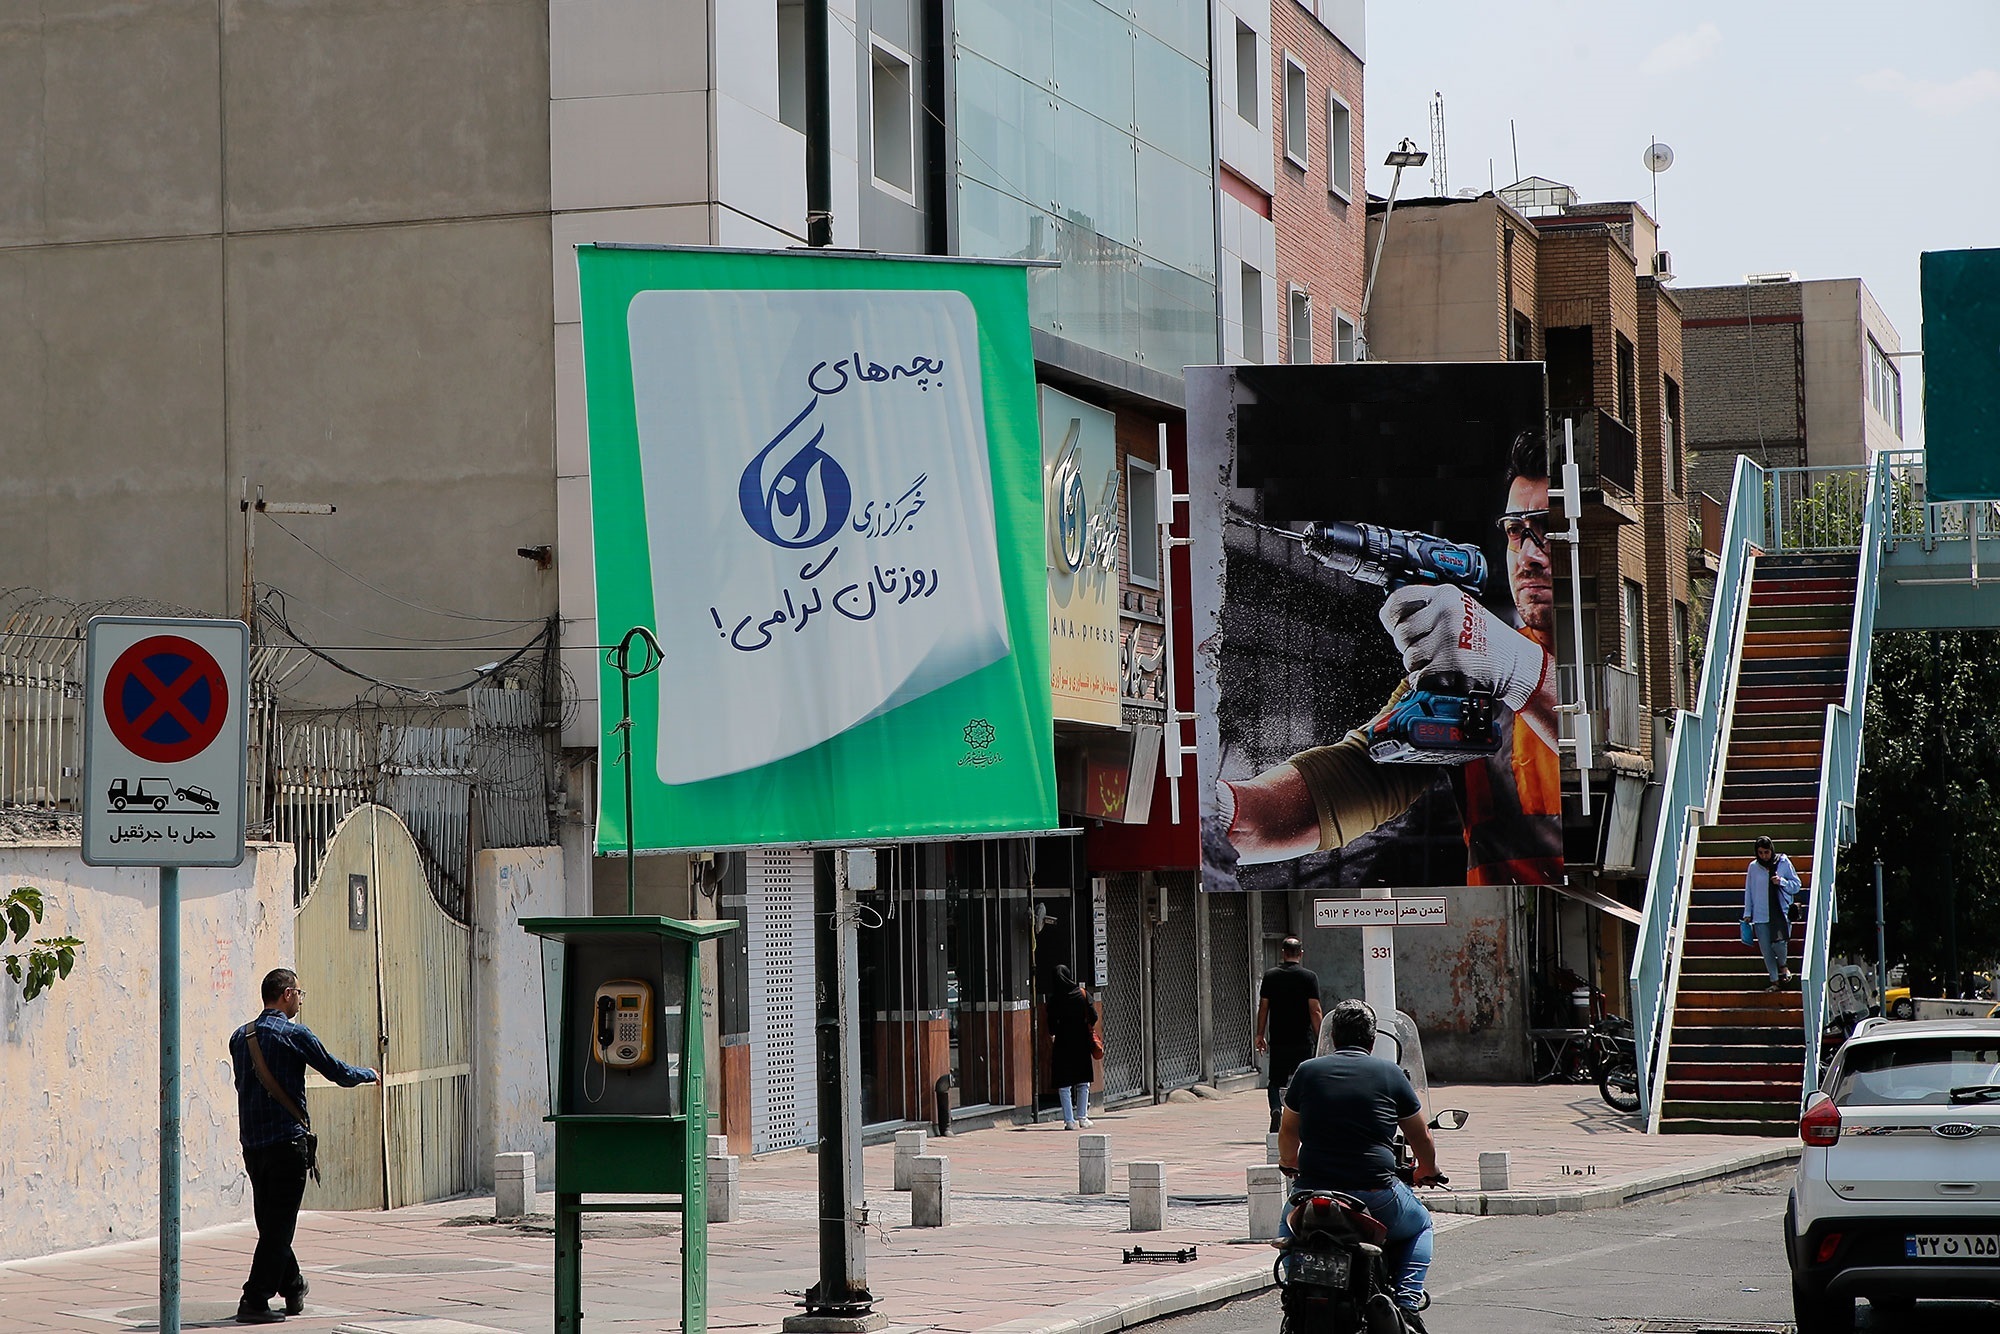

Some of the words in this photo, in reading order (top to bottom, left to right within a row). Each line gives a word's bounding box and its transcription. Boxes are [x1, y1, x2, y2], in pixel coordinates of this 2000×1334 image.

[852, 472, 928, 539] خبرگزاری
[832, 564, 939, 621] روزتان
[1052, 616, 1114, 644] ANA.press
[109, 823, 163, 844] جرثقیل
[167, 825, 179, 842] با
[182, 826, 216, 844] حمل
[1318, 908, 1339, 918] ۰۹۱۲
[1342, 908, 1350, 918] ۴
[1353, 908, 1371, 918] ۲۰۰
[1375, 907, 1395, 917] ۳۰۰
[1399, 906, 1418, 918] هنر
[1419, 906, 1444, 917] تمدن
[1371, 947, 1391, 958] 331
